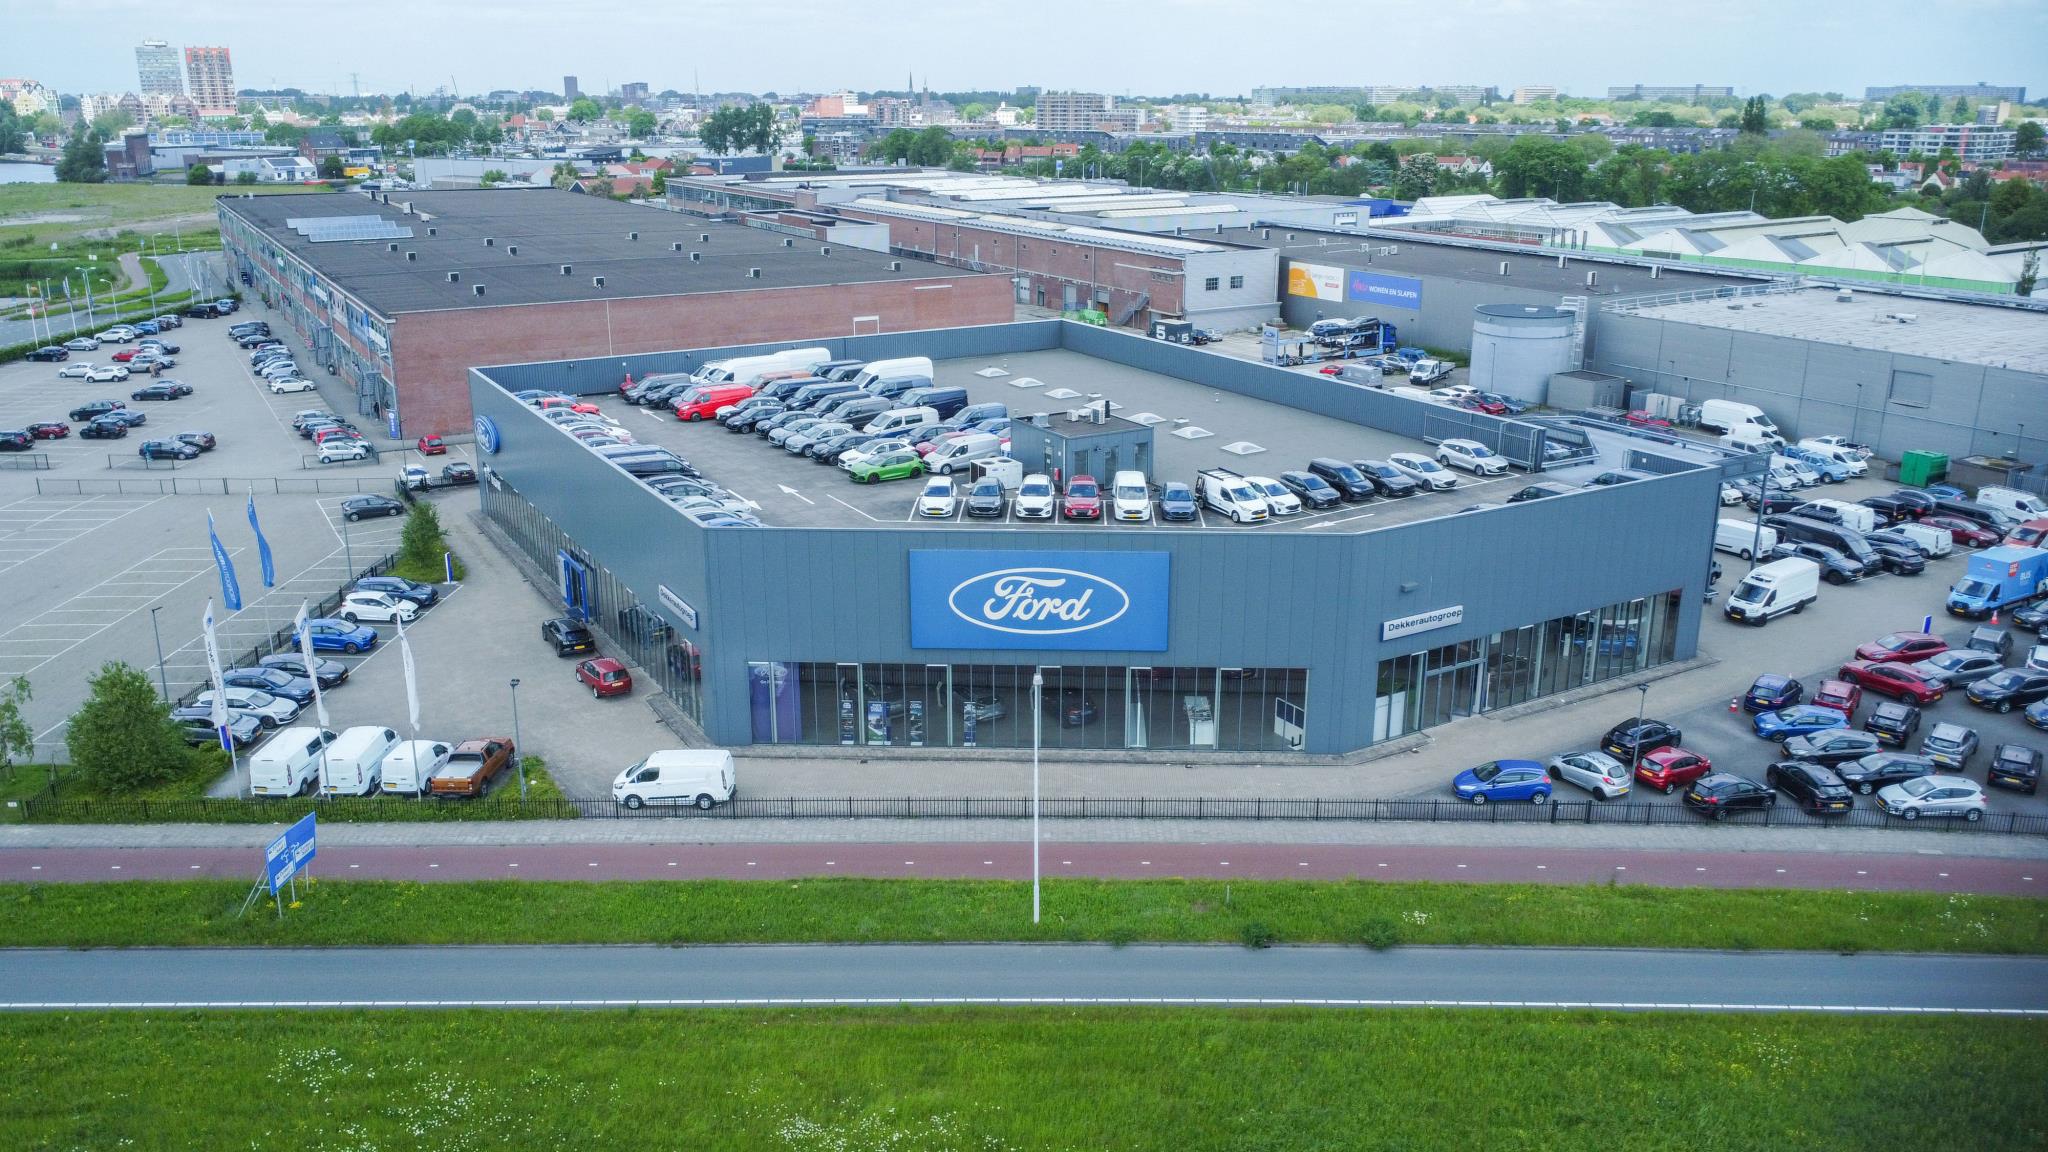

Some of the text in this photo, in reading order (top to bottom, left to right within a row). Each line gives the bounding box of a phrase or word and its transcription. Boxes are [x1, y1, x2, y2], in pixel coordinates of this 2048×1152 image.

[1368, 285, 1388, 295] WONEN
[1389, 288, 1396, 296] EN
[1396, 289, 1417, 299] SLAPEN
[983, 575, 1094, 621] Ford
[1388, 609, 1463, 632] Dekkerautogroep
